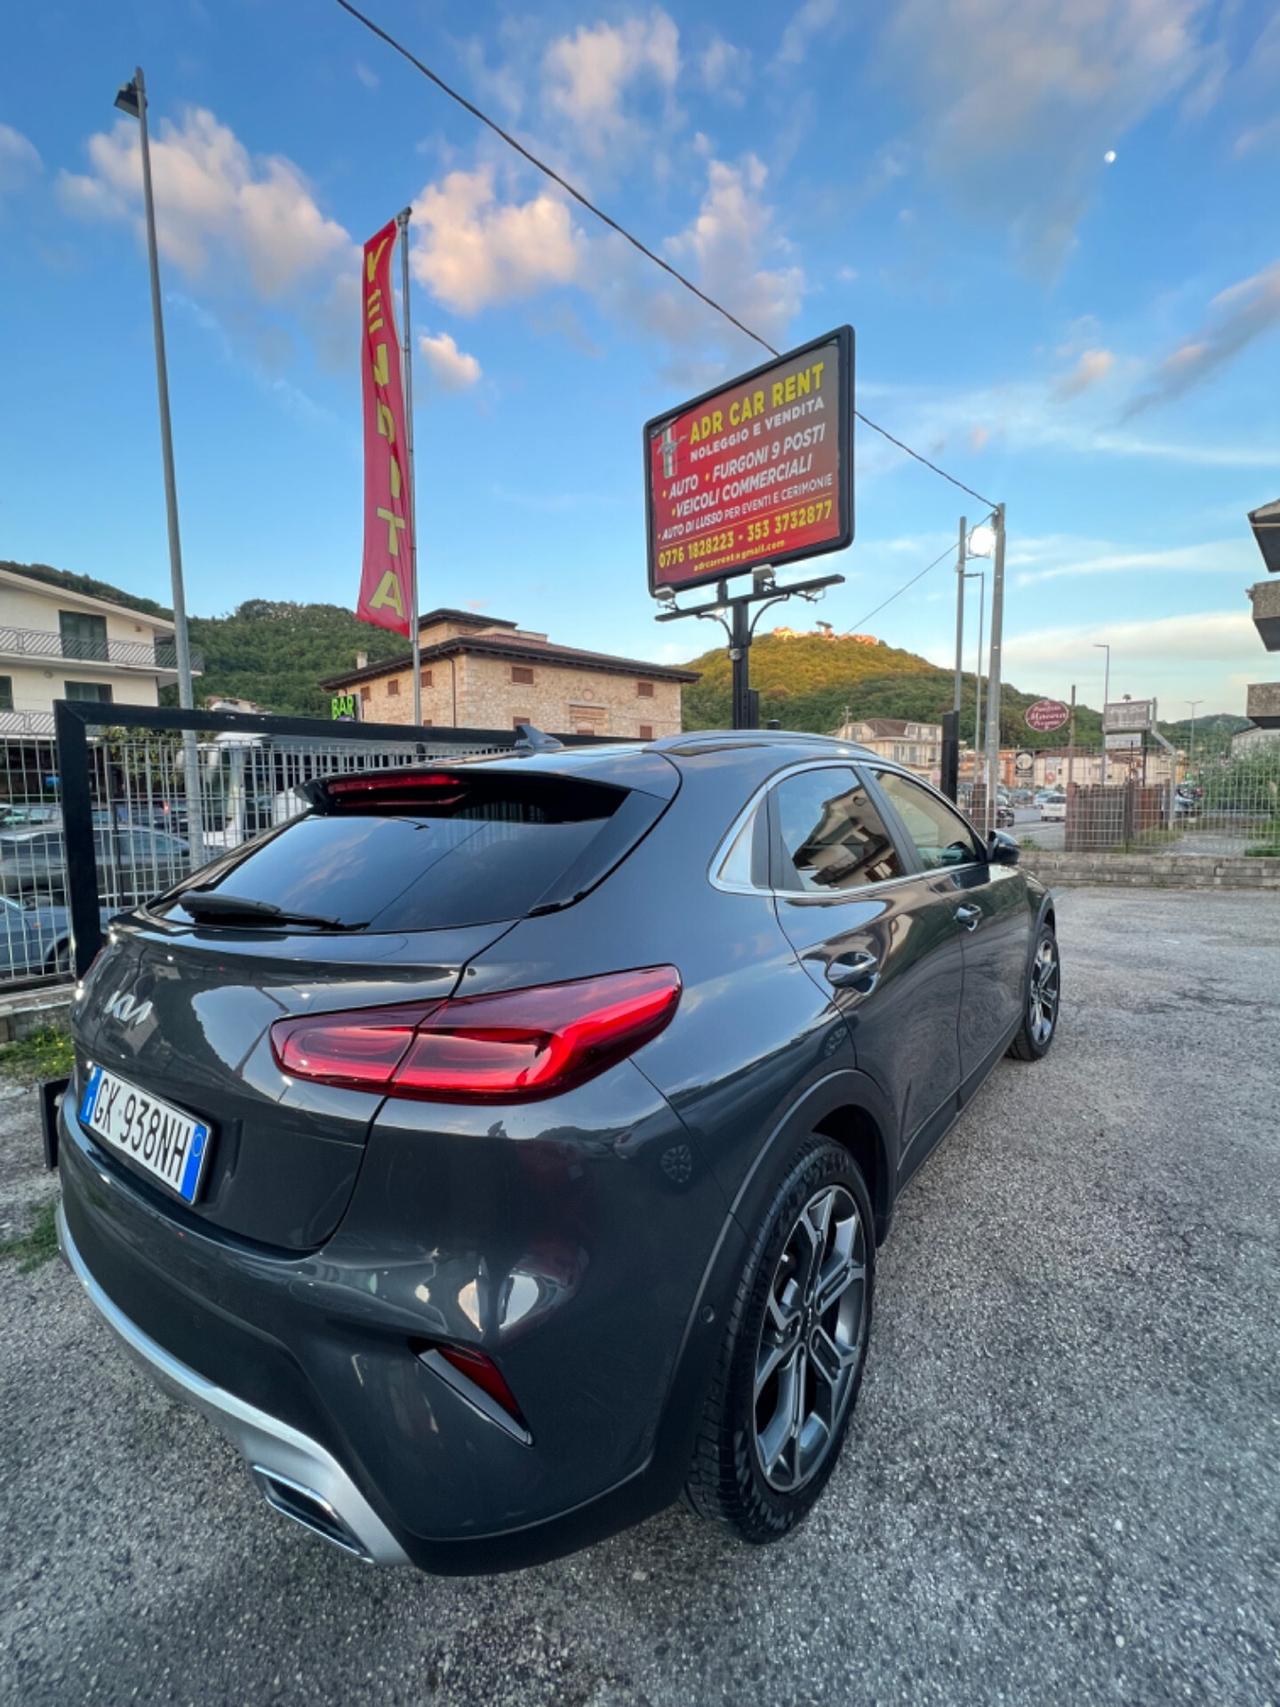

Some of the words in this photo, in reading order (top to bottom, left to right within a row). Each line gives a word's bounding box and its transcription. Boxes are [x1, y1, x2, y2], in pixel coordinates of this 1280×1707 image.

[366, 236, 406, 617] VENDITA
[690, 410, 724, 445] ADR
[729, 390, 765, 426] CAR
[771, 362, 824, 408] RENT
[690, 429, 749, 463] NOLEGGIO
[753, 422, 761, 437] E
[765, 396, 824, 430] VENDITA
[668, 474, 698, 499] AUTO
[712, 444, 769, 483] FURGONI
[771, 442, 780, 460] 9
[784, 423, 826, 455] POSTI
[676, 488, 720, 518] VEICOLI
[722, 453, 812, 501] COMMERCIALI
[658, 546, 685, 569] 0776
[747, 519, 770, 543] 353
[774, 499, 833, 535] 3732877
[661, 524, 684, 541] AUTO
[686, 520, 695, 532] DI
[695, 510, 724, 531] LUSSO
[724, 508, 741, 522] PER
[742, 495, 772, 515] EVENTI
[773, 492, 779, 503] E
[781, 473, 833, 500] CERIMONIE
[331, 695, 355, 721] BAR
[103, 990, 154, 1026] KIA
[120, 1093, 191, 1184] 938NH
